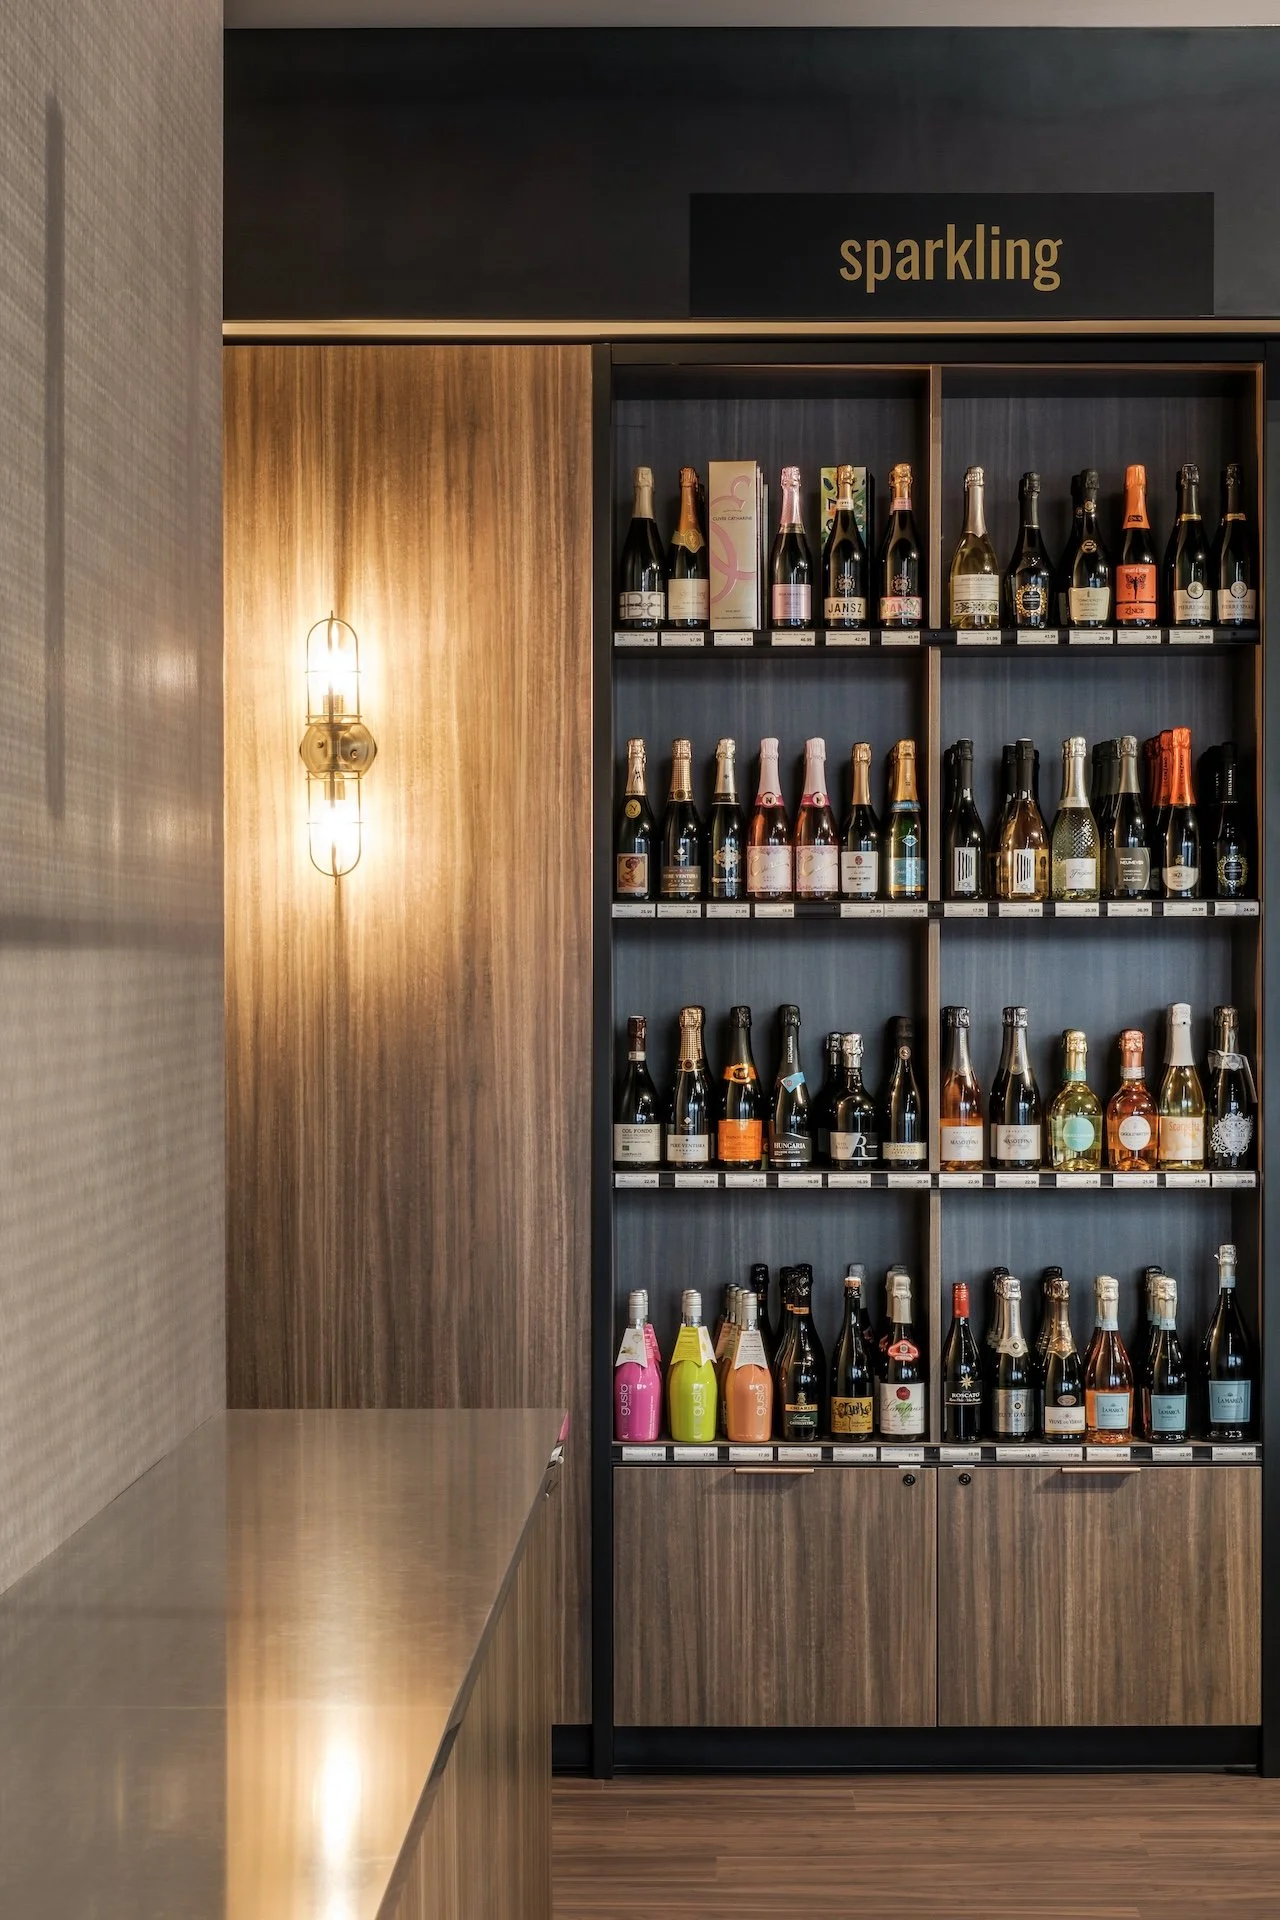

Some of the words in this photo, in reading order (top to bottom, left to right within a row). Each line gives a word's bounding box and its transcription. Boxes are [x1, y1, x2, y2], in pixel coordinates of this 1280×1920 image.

[839, 223, 1063, 293] sparkling
[828, 603, 862, 613] JANSZ
[884, 604, 918, 613] JANSZ
[620, 1384, 630, 1416] gusto
[755, 1384, 766, 1416] gusto
